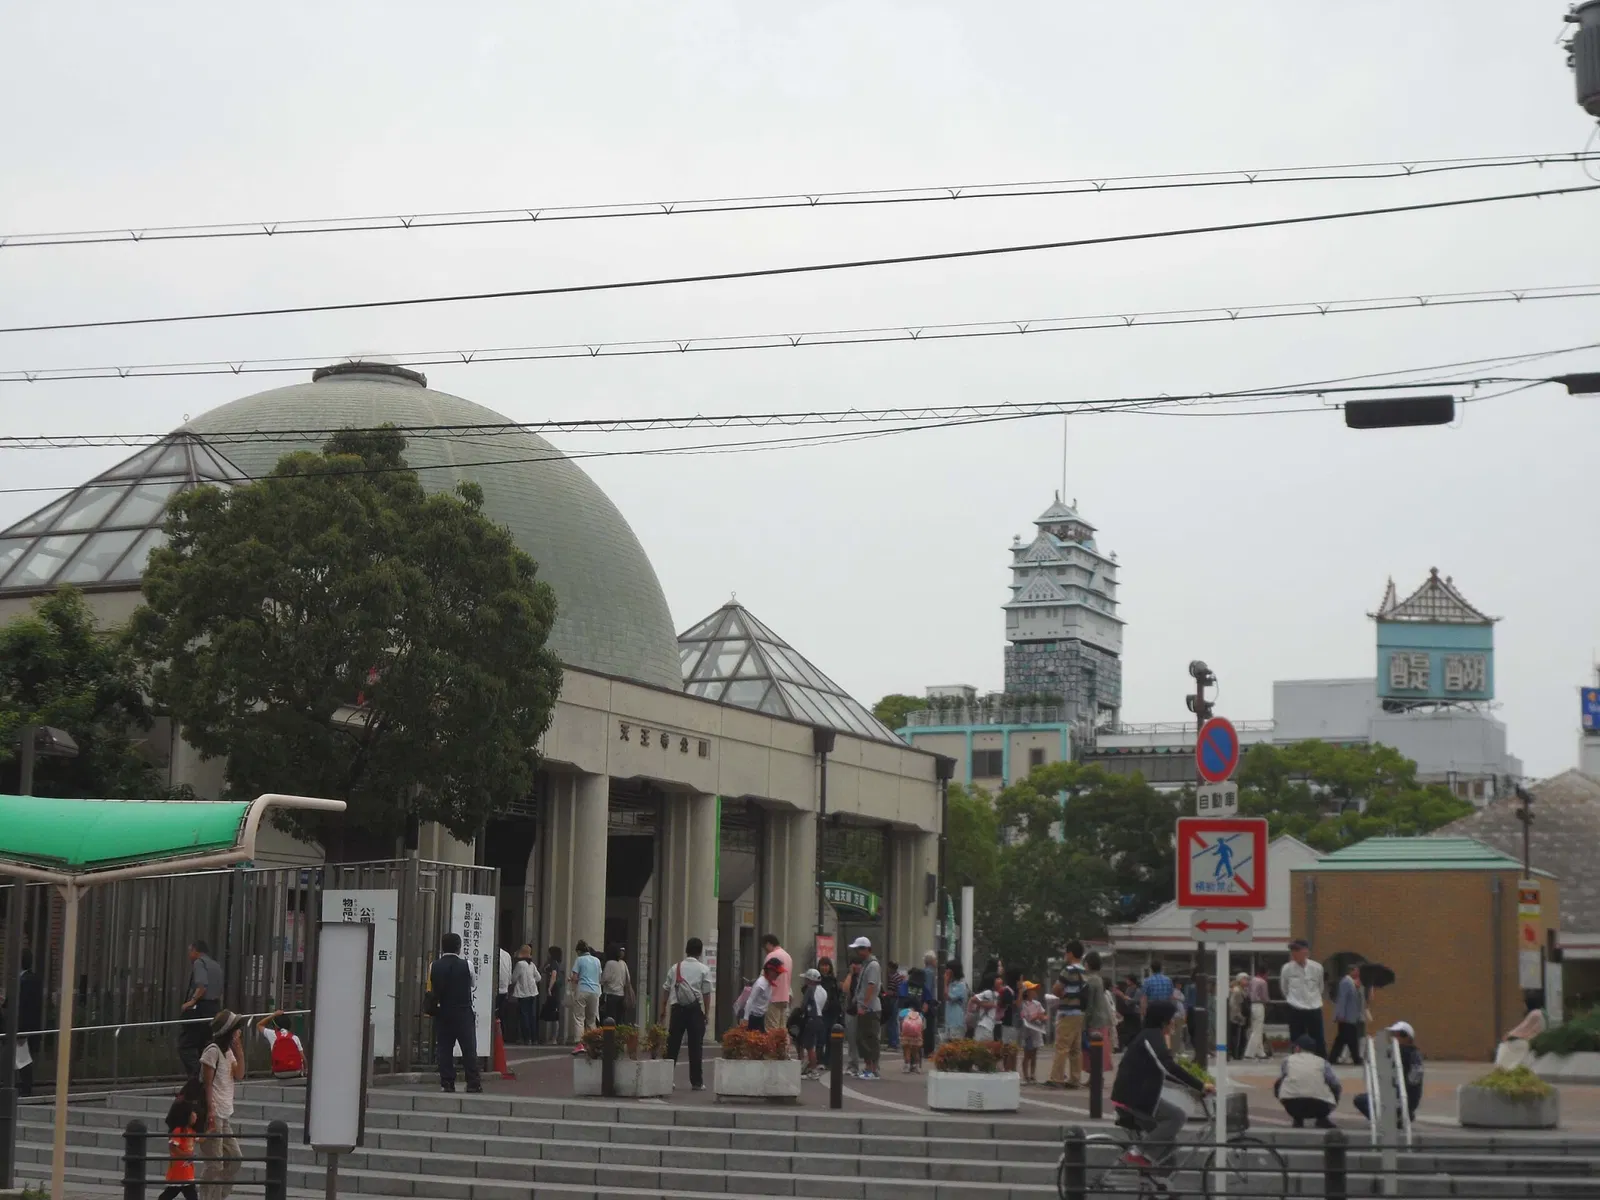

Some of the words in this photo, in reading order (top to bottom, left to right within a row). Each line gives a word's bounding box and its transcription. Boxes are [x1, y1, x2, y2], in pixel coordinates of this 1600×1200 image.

[1199, 791, 1235, 809] 自動車
[378, 949, 388, 961] 告
